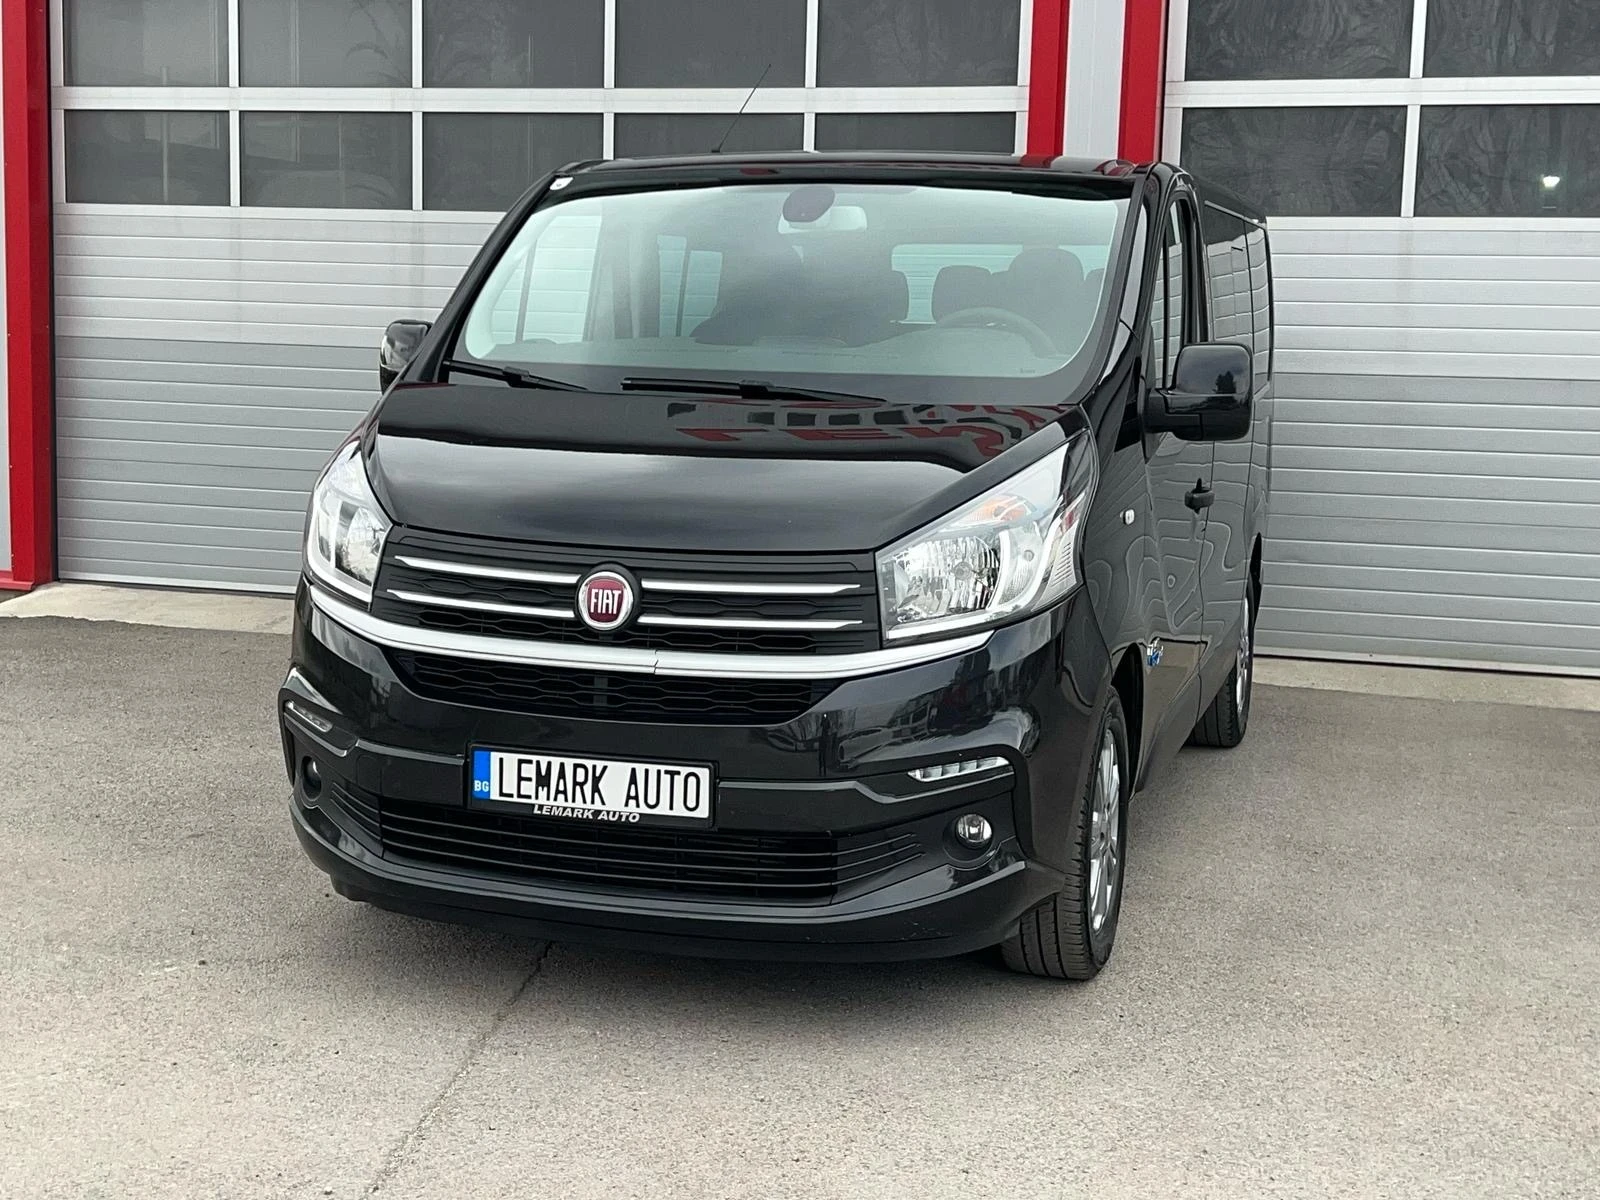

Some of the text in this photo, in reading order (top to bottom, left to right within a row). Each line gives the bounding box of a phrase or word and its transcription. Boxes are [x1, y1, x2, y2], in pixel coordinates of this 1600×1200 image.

[590, 588, 621, 615] FIAT
[474, 780, 490, 792] BG
[498, 757, 701, 812] LEMARK AUTO
[533, 805, 640, 823] LEMARK AUTO
